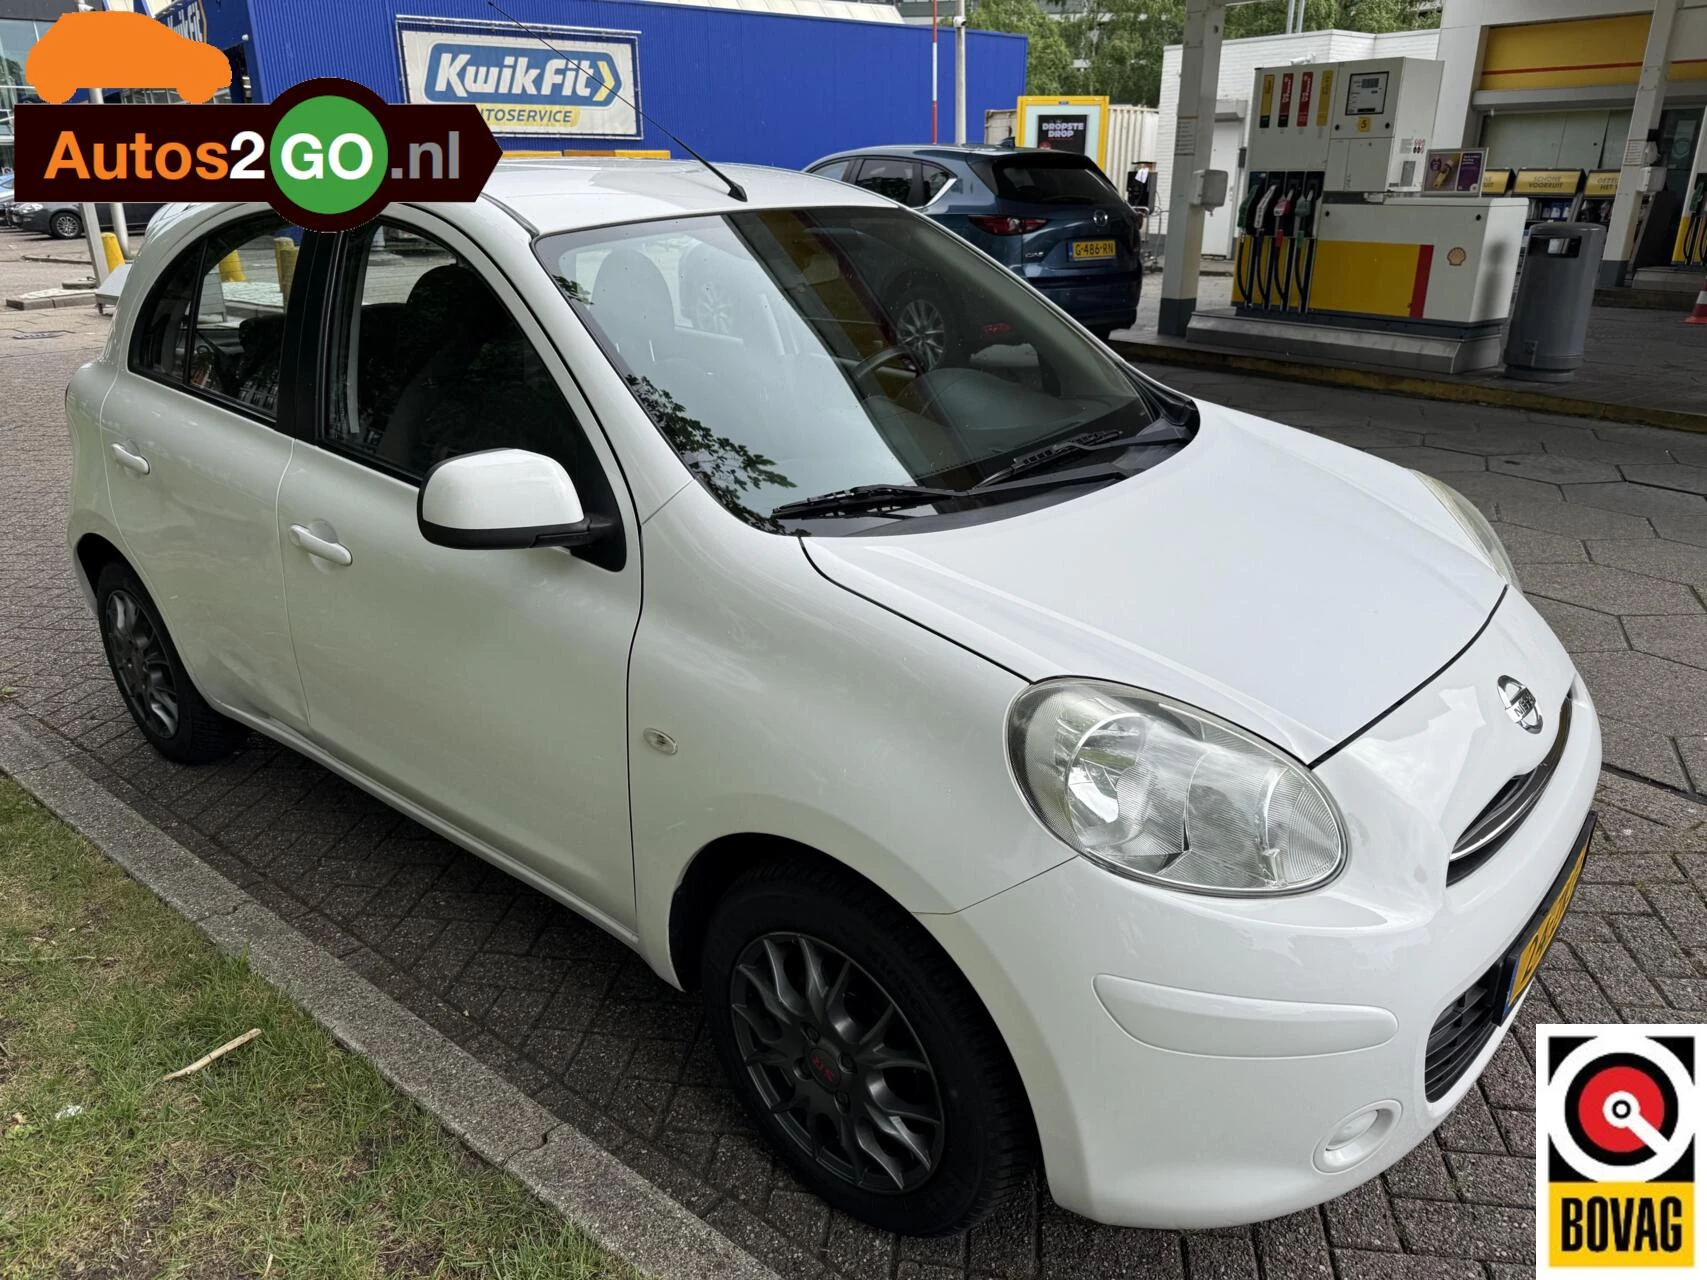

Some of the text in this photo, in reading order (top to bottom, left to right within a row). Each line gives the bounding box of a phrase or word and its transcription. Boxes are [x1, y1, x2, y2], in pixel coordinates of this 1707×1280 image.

[481, 108, 573, 123] TOSERVICE
[1360, 119, 1368, 129] 5
[1047, 130, 1075, 138] DROP
[1075, 242, 1114, 256] G-486-RN
